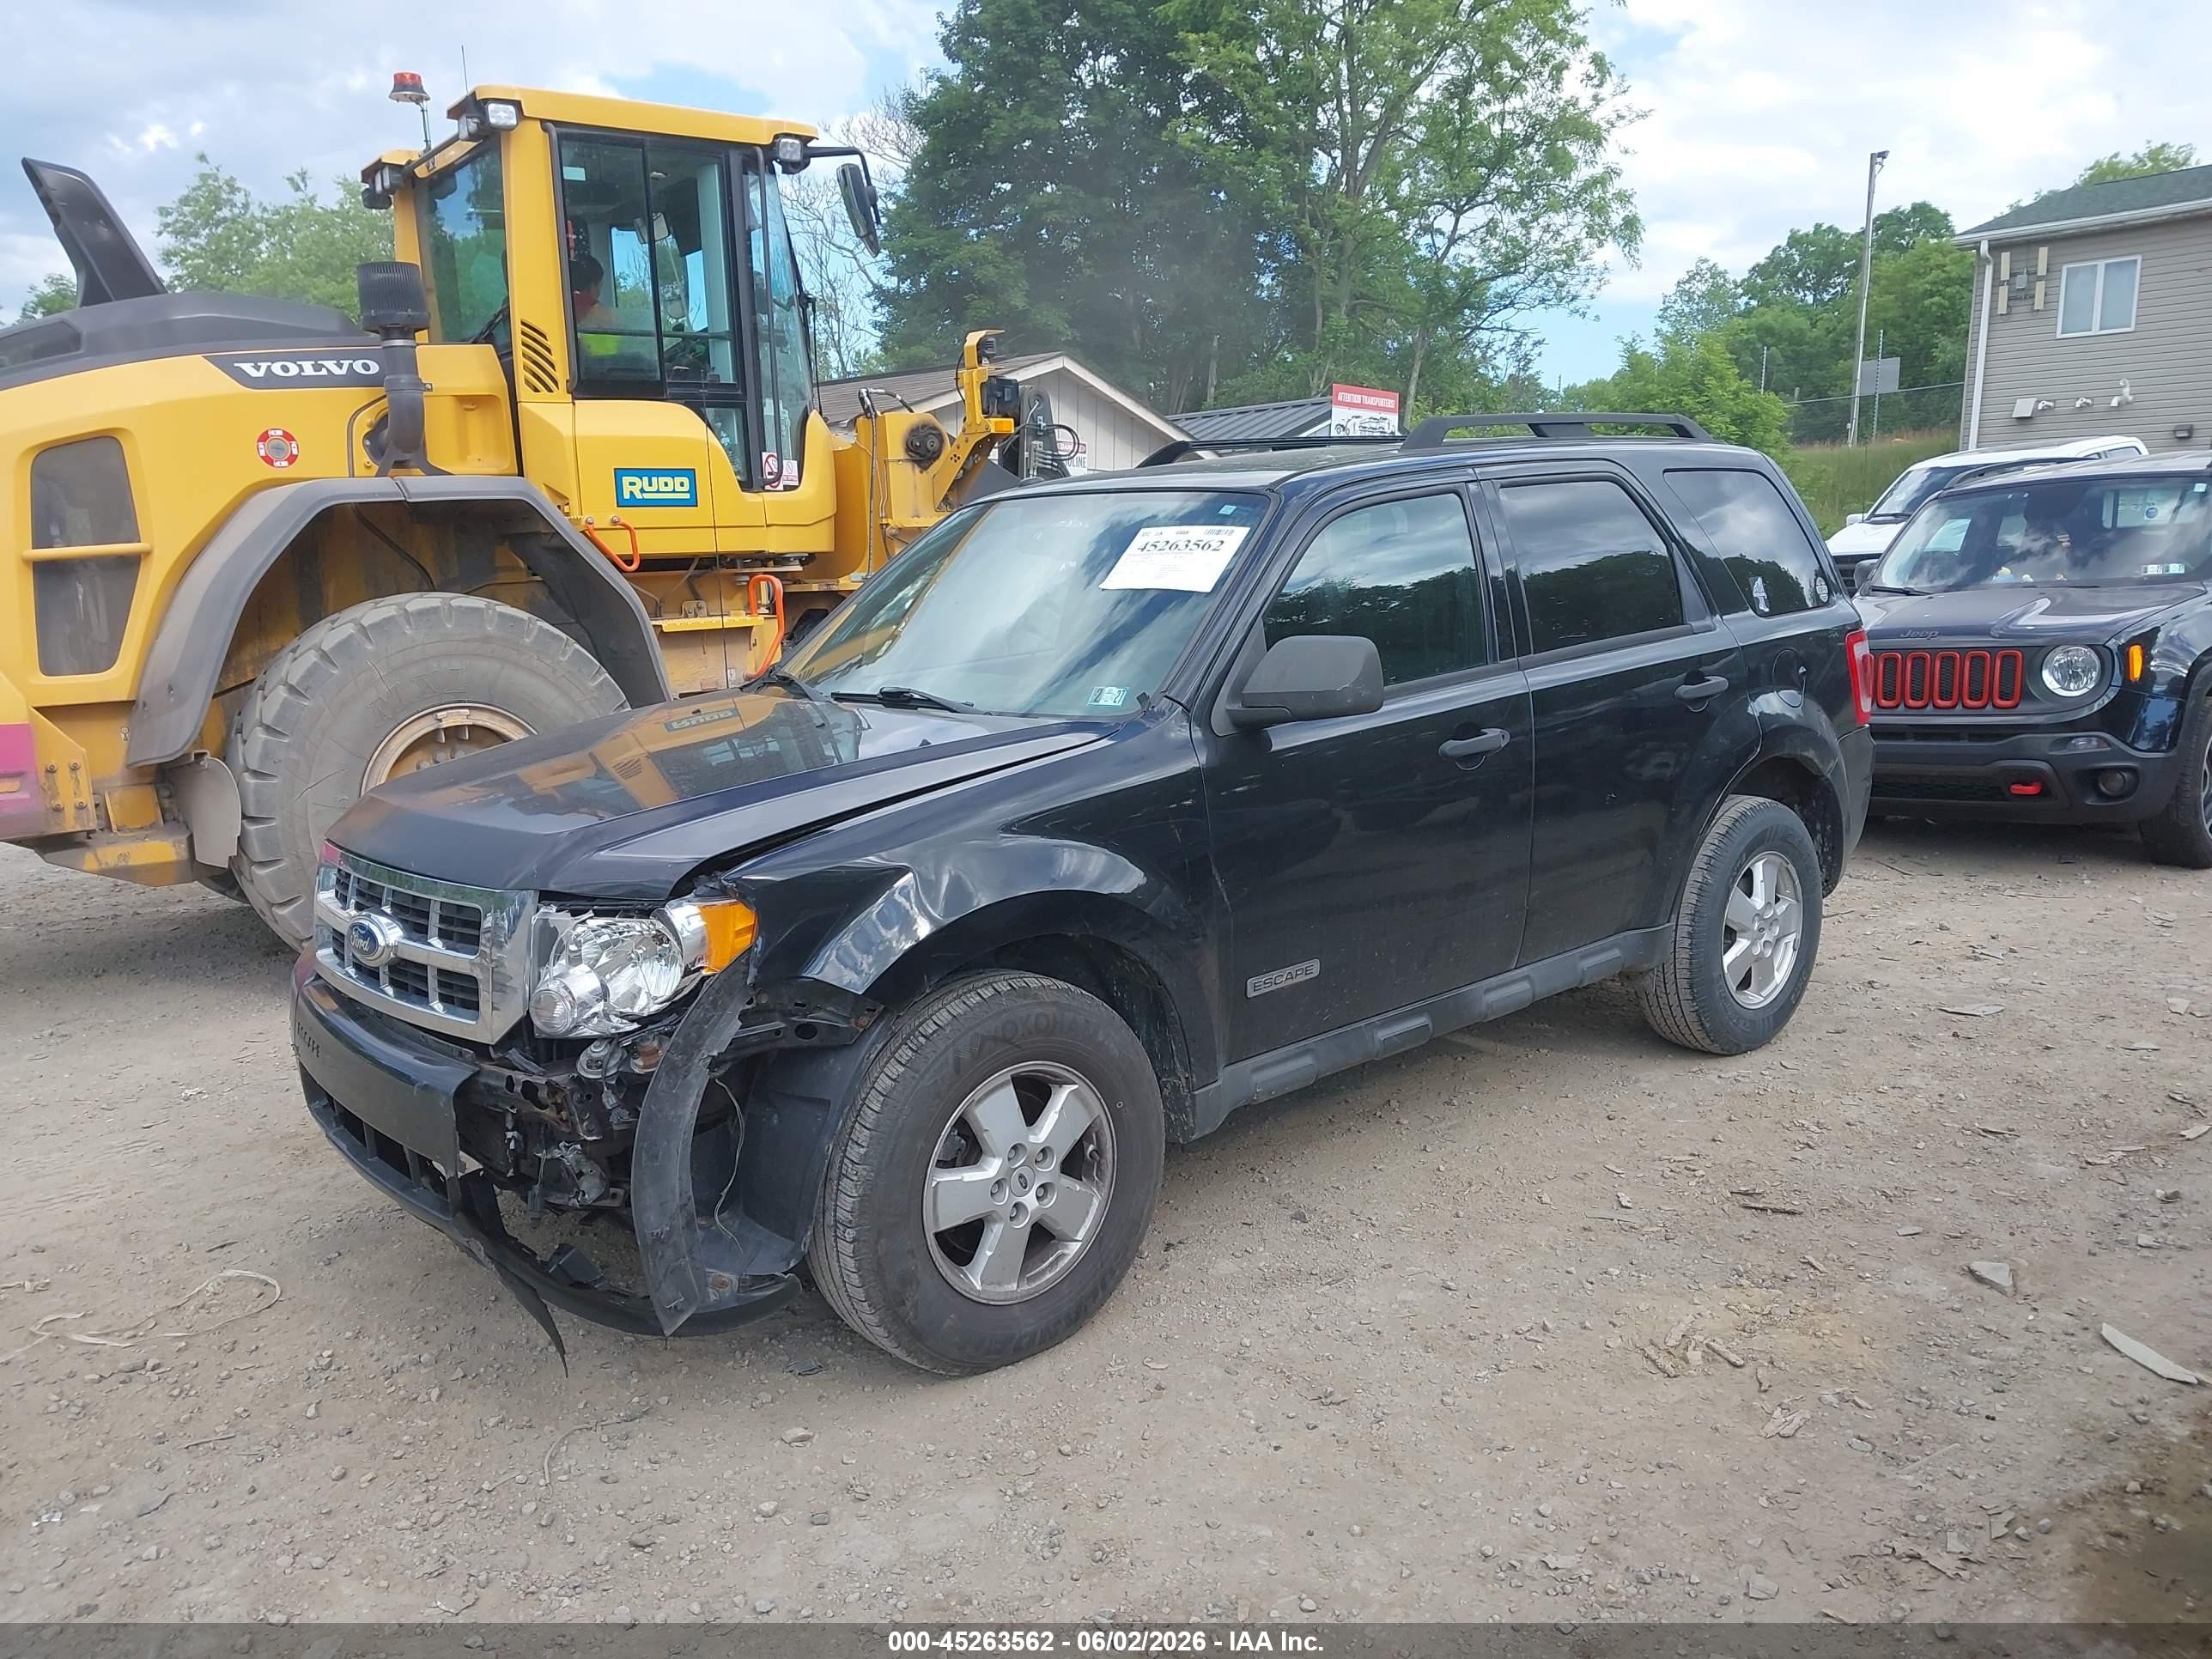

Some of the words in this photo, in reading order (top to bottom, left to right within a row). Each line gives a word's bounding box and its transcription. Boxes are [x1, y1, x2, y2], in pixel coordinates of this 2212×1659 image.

[234, 359, 380, 378] VOLVO
[1338, 392, 1361, 404] ATTENTION
[622, 476, 690, 499] RUDD
[1137, 539, 1225, 553] 45263562
[1899, 629, 1939, 641] Jeep
[349, 927, 371, 952] Ford
[1253, 963, 1315, 992] ESCAPE
